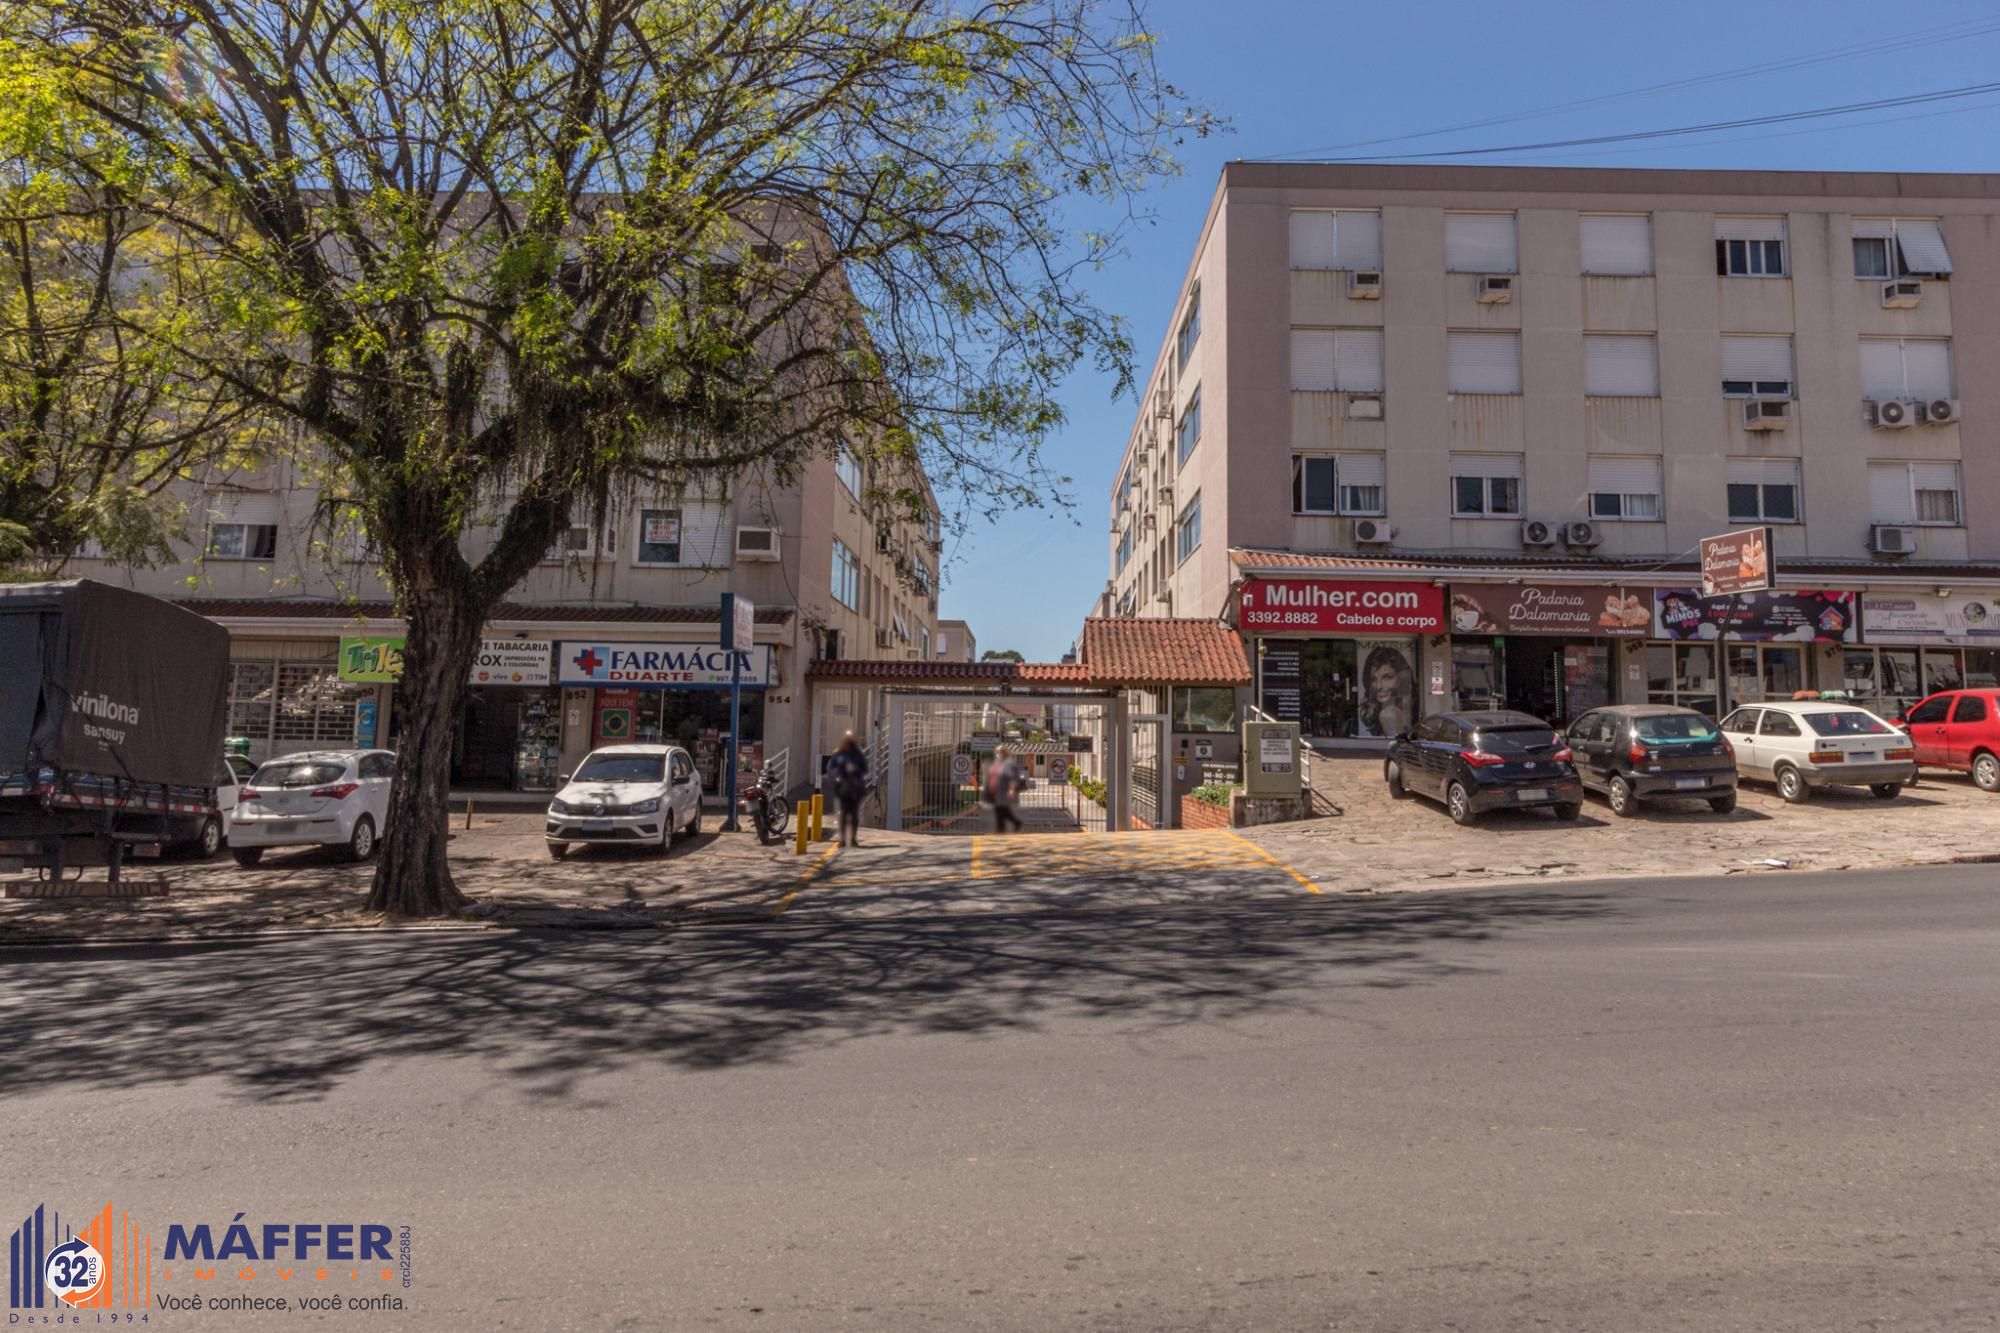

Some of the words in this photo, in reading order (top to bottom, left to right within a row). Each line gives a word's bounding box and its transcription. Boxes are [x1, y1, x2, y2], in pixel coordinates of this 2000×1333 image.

[1266, 585, 1418, 608] Mulher.com
[1521, 588, 1585, 605] Padaria
[1247, 611, 1318, 624] 3392.8882
[1336, 612, 1384, 626] Cabelo
[1386, 617, 1394, 625] e
[1397, 616, 1437, 628] corpo
[1665, 608, 1701, 625] MIMOS
[493, 642, 549, 651] TABACARIA
[1358, 641, 1414, 649] MATRIX
[611, 647, 752, 672] FARMÁCIA
[609, 671, 694, 681] DUARTE
[70, 690, 139, 725] vinilona
[768, 695, 791, 704] 954
[83, 723, 126, 745] sansuy
[956, 759, 967, 768] 10
